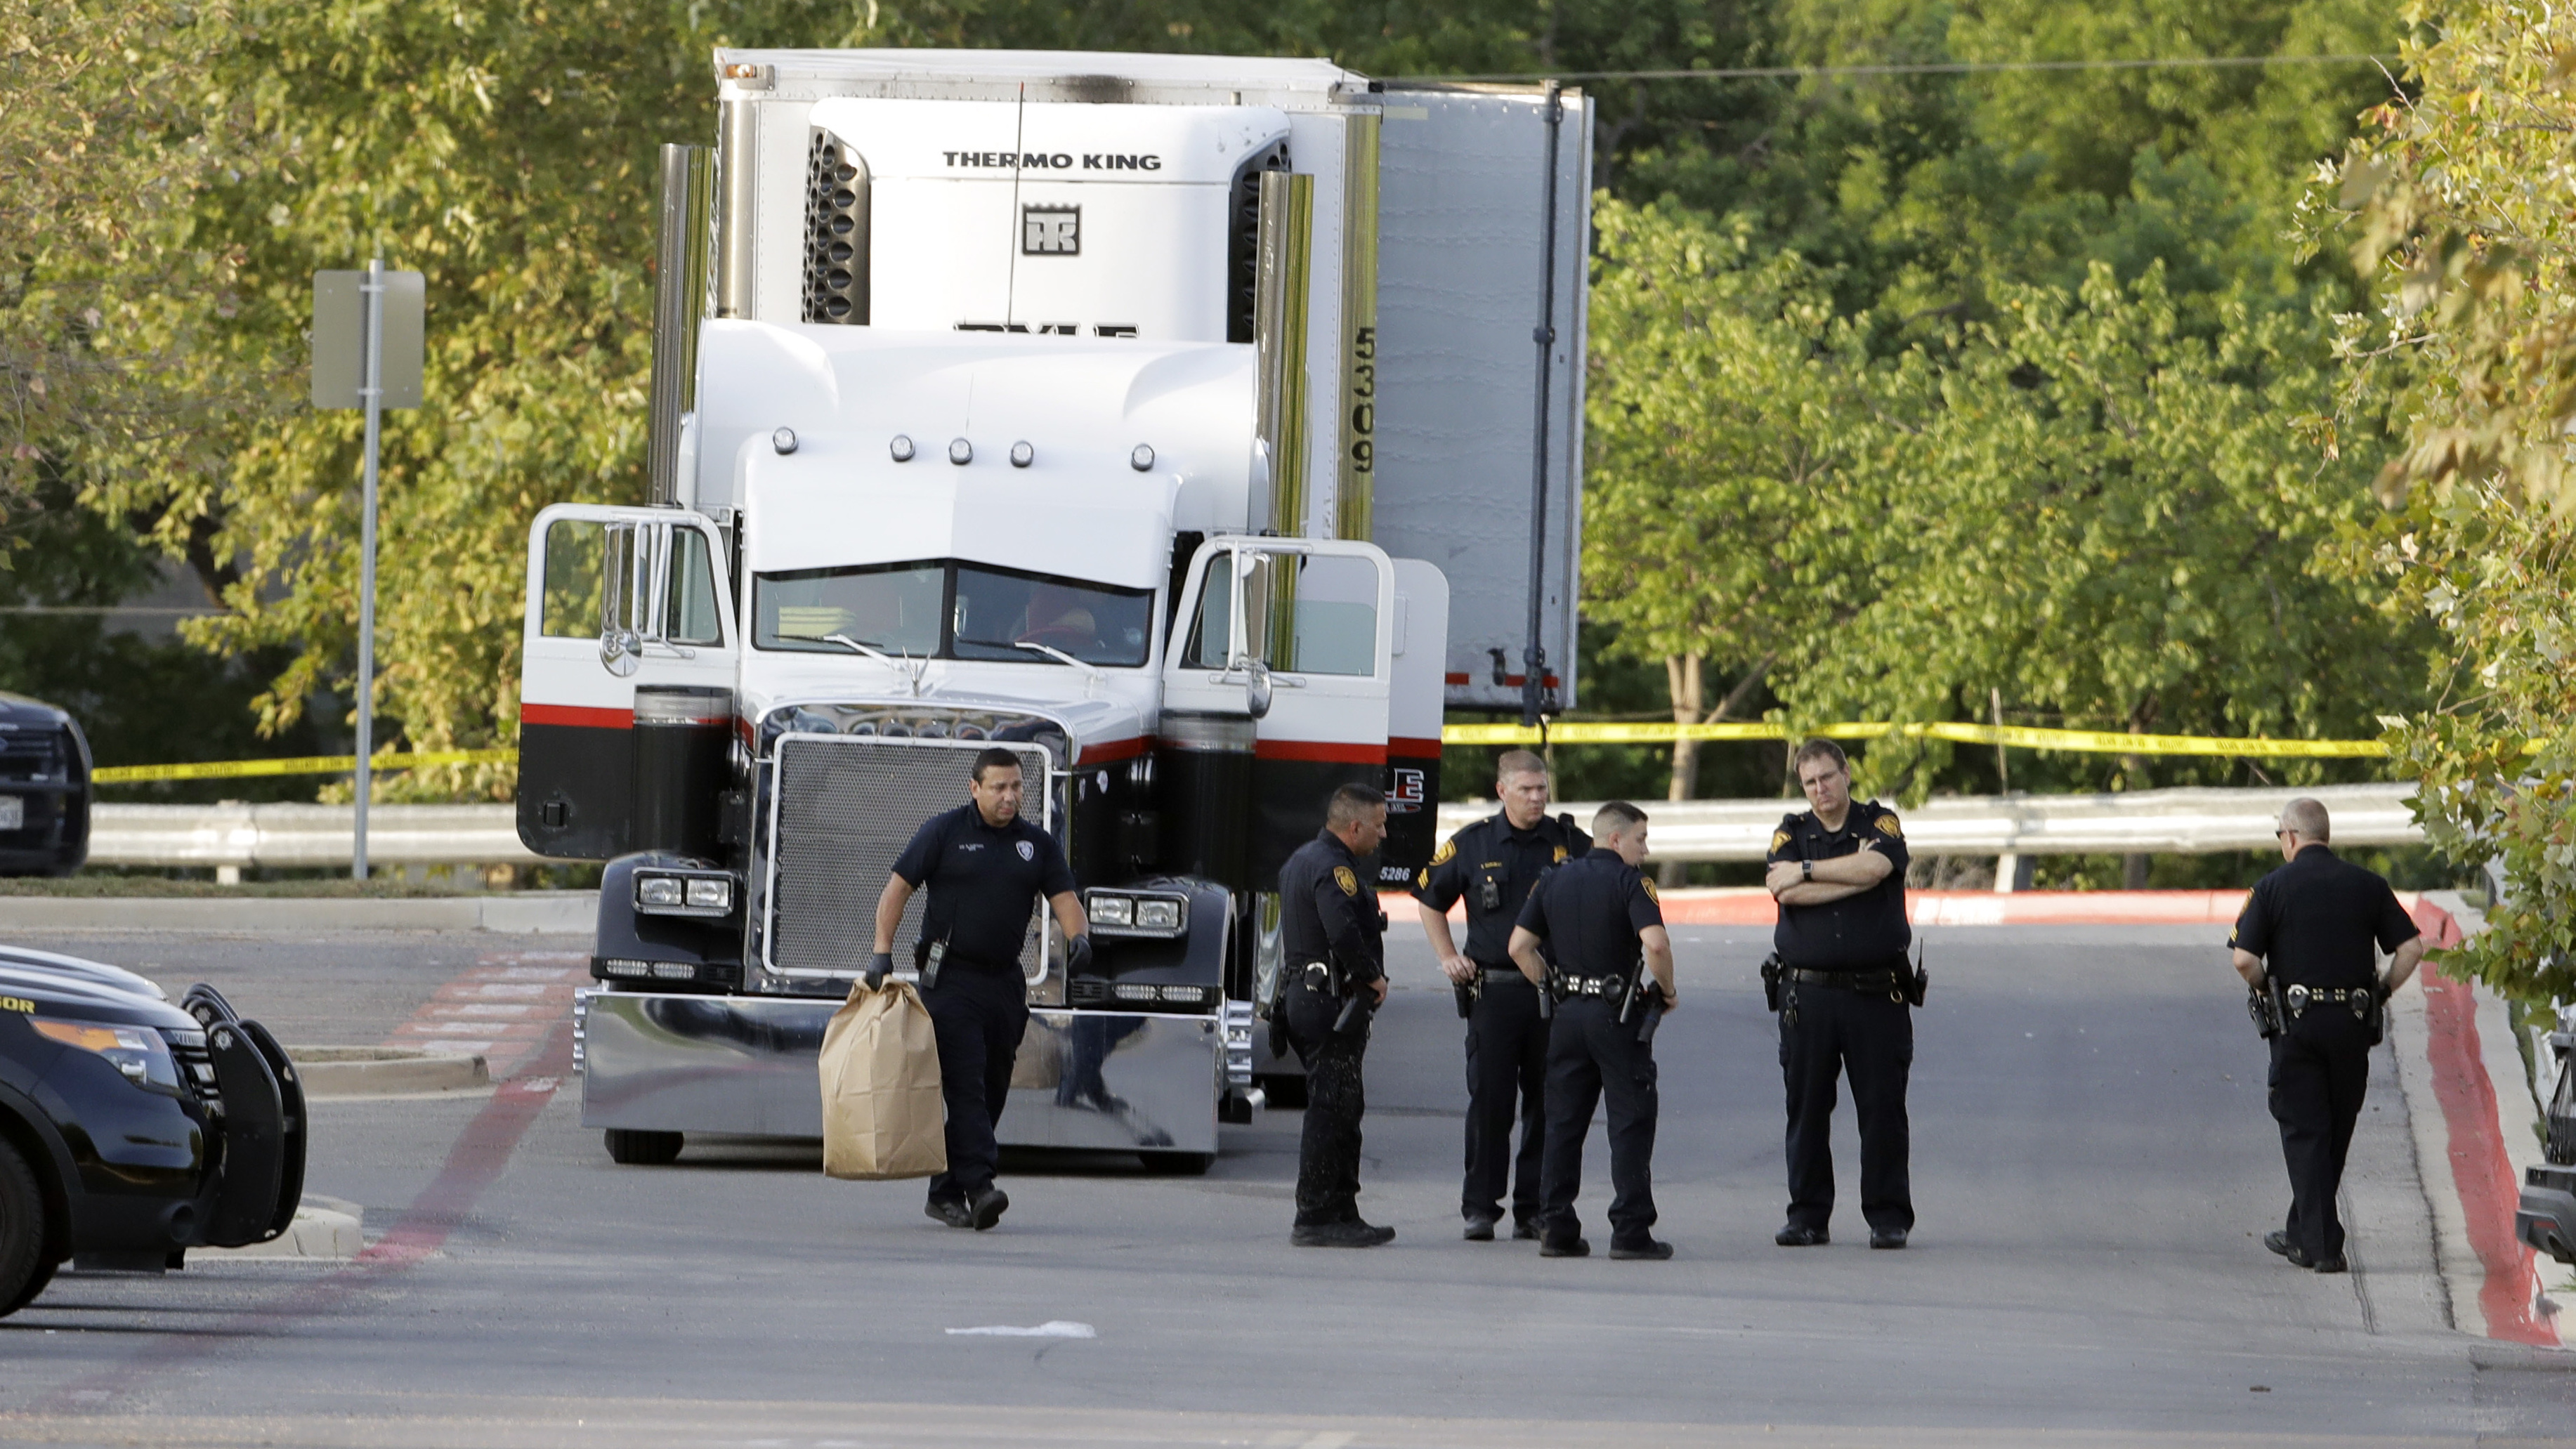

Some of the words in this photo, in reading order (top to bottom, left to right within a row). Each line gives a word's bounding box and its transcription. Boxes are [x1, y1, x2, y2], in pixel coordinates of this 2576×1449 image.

[943, 151, 1073, 169] THERMO
[1083, 154, 1161, 171] KING
[1352, 327, 1375, 473] 5309
[1380, 866, 1411, 881] 5286
[0, 995, 35, 1014] OR
